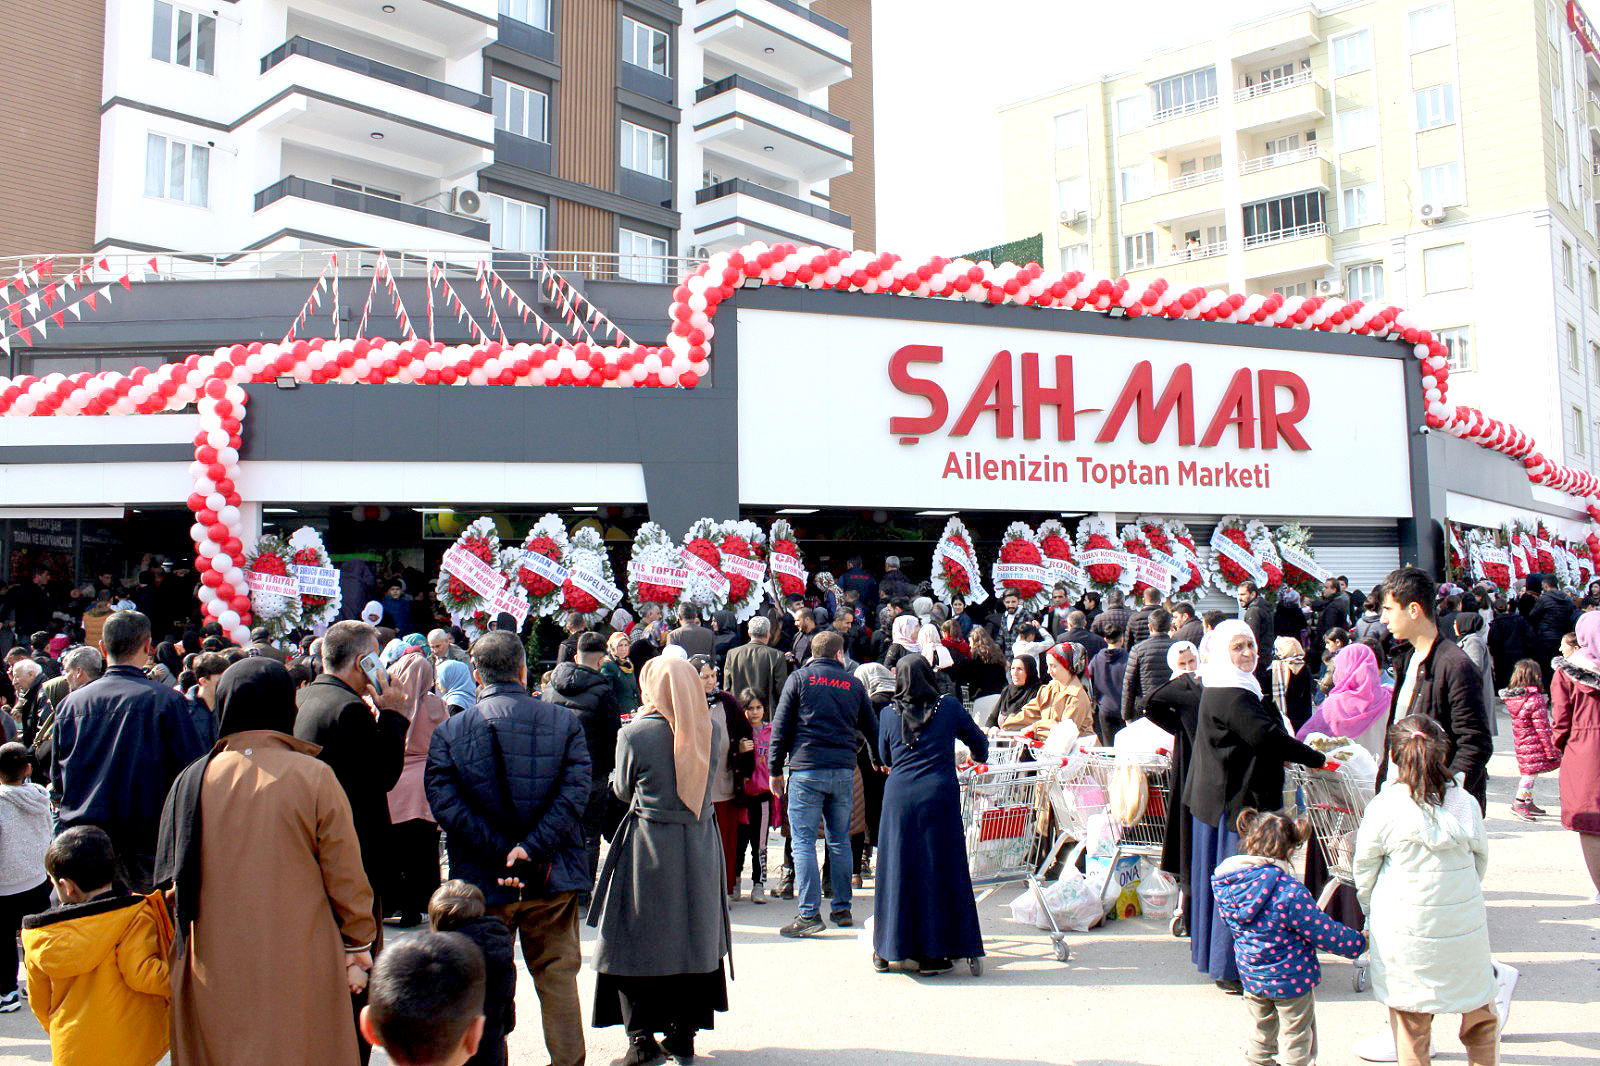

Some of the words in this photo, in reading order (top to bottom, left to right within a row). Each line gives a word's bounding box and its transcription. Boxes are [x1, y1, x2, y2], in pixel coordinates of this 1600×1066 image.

[942, 451, 1067, 482] Ailenizin
[1076, 456, 1169, 489] Toptan
[1178, 460, 1270, 488] Marketi
[650, 565, 688, 578] TOPTAN
[726, 554, 765, 572] PAZARLAMA
[576, 570, 601, 589] NUPEL
